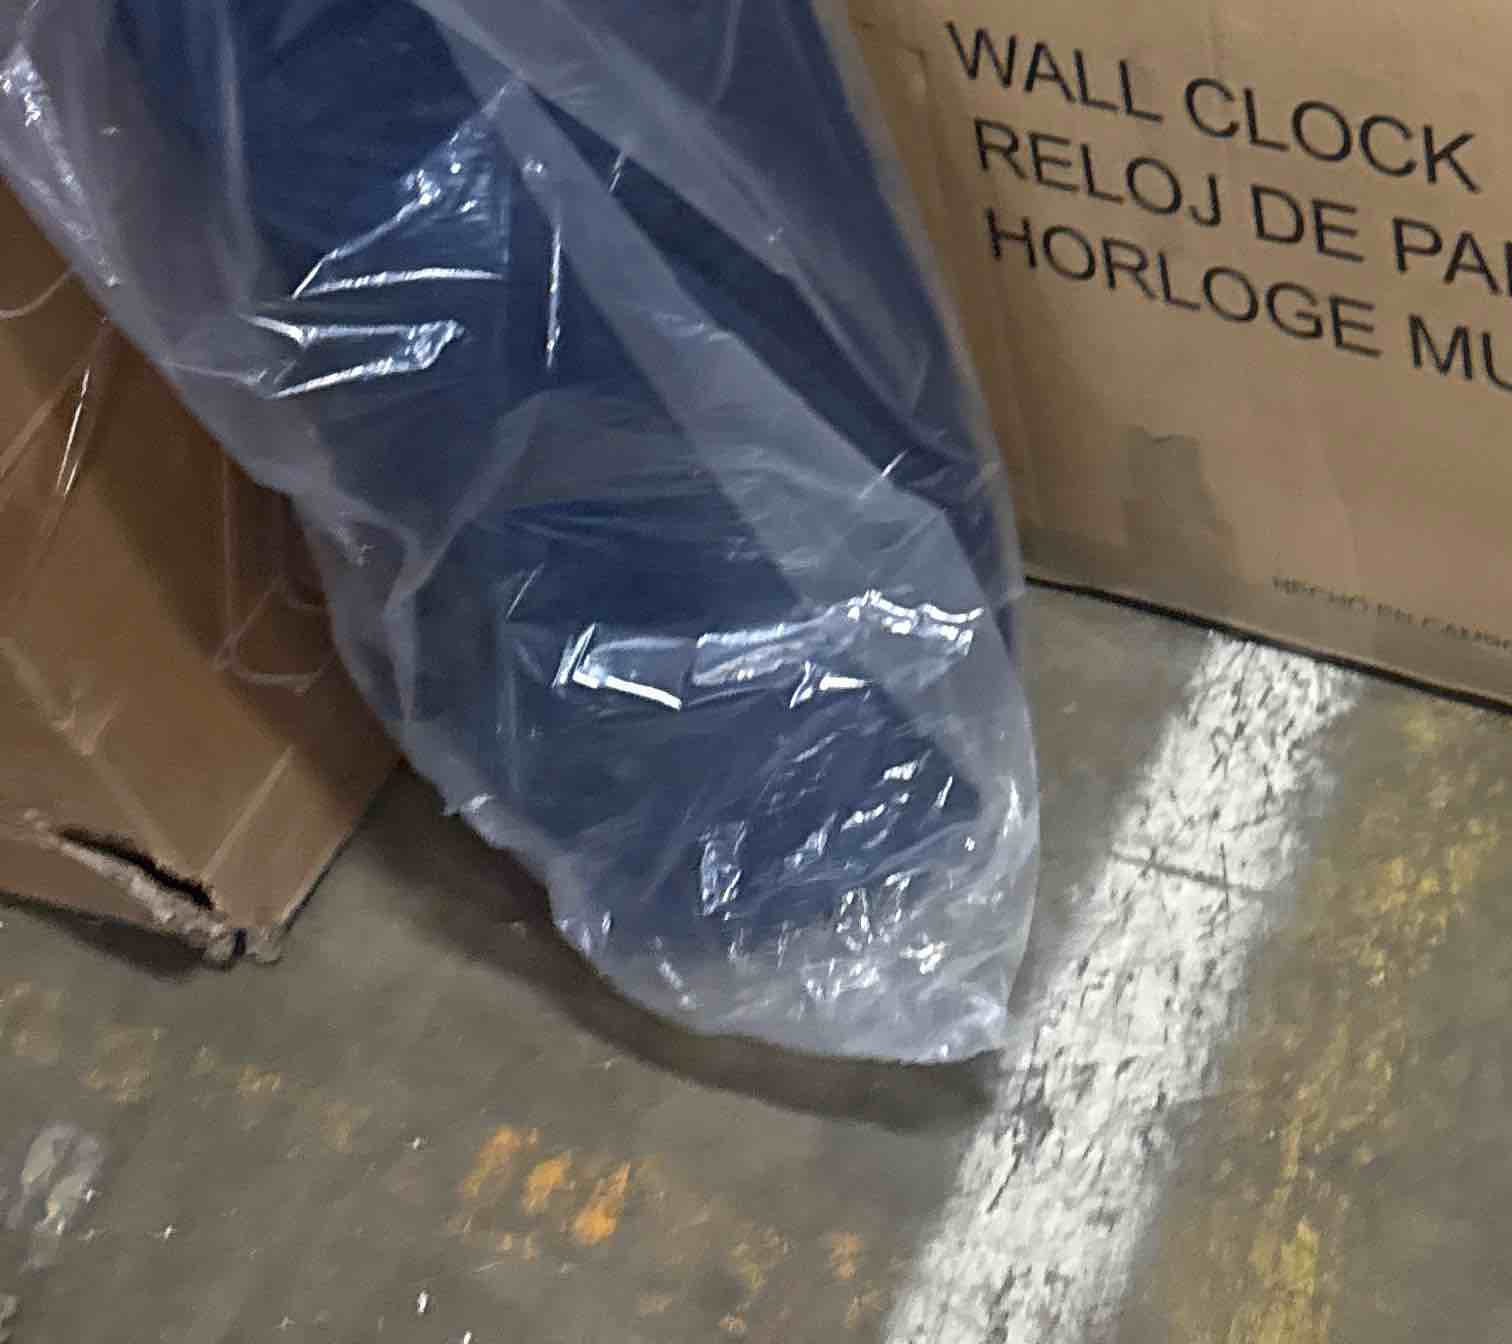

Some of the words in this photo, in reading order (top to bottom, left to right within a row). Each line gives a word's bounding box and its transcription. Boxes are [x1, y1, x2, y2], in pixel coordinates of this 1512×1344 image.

[944, 20, 1164, 125] WALL
[1183, 77, 1481, 194] CLOCK
[972, 118, 1222, 228] RELOJ
[1250, 184, 1366, 263] DE
[985, 207, 1383, 358] HORLOGE
